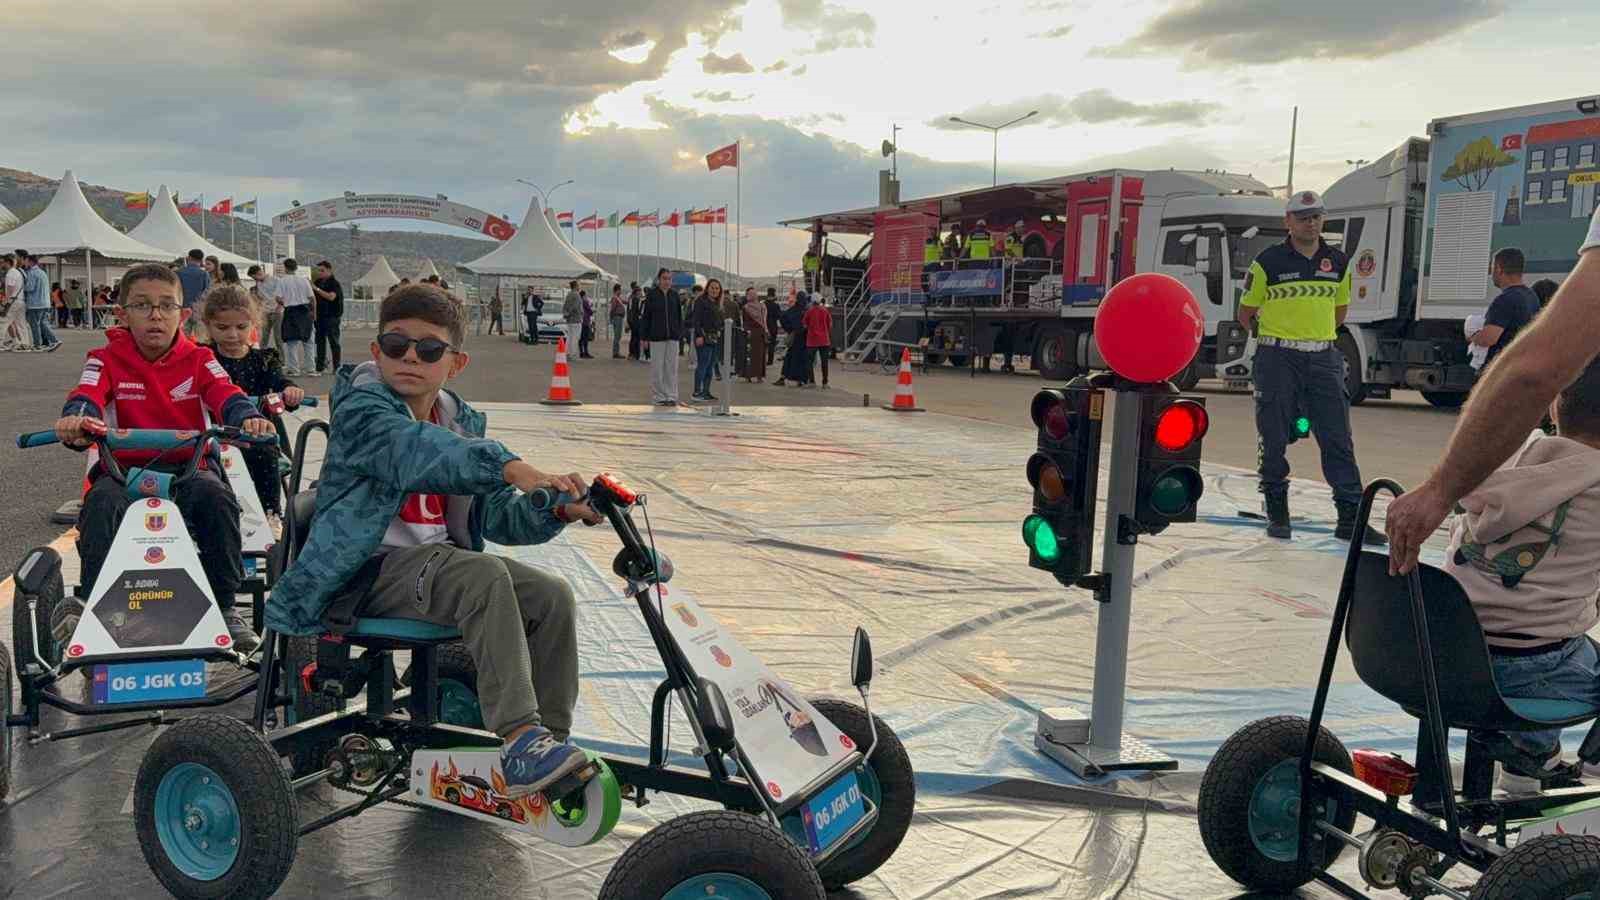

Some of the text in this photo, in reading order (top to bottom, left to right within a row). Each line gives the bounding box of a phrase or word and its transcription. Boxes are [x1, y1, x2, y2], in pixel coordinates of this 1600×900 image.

[128, 590, 174, 601] GÖRÜNÜR
[128, 601, 143, 610] OL
[112, 672, 203, 691] 06 JGK 03
[815, 783, 861, 830] 06 JGK 01
